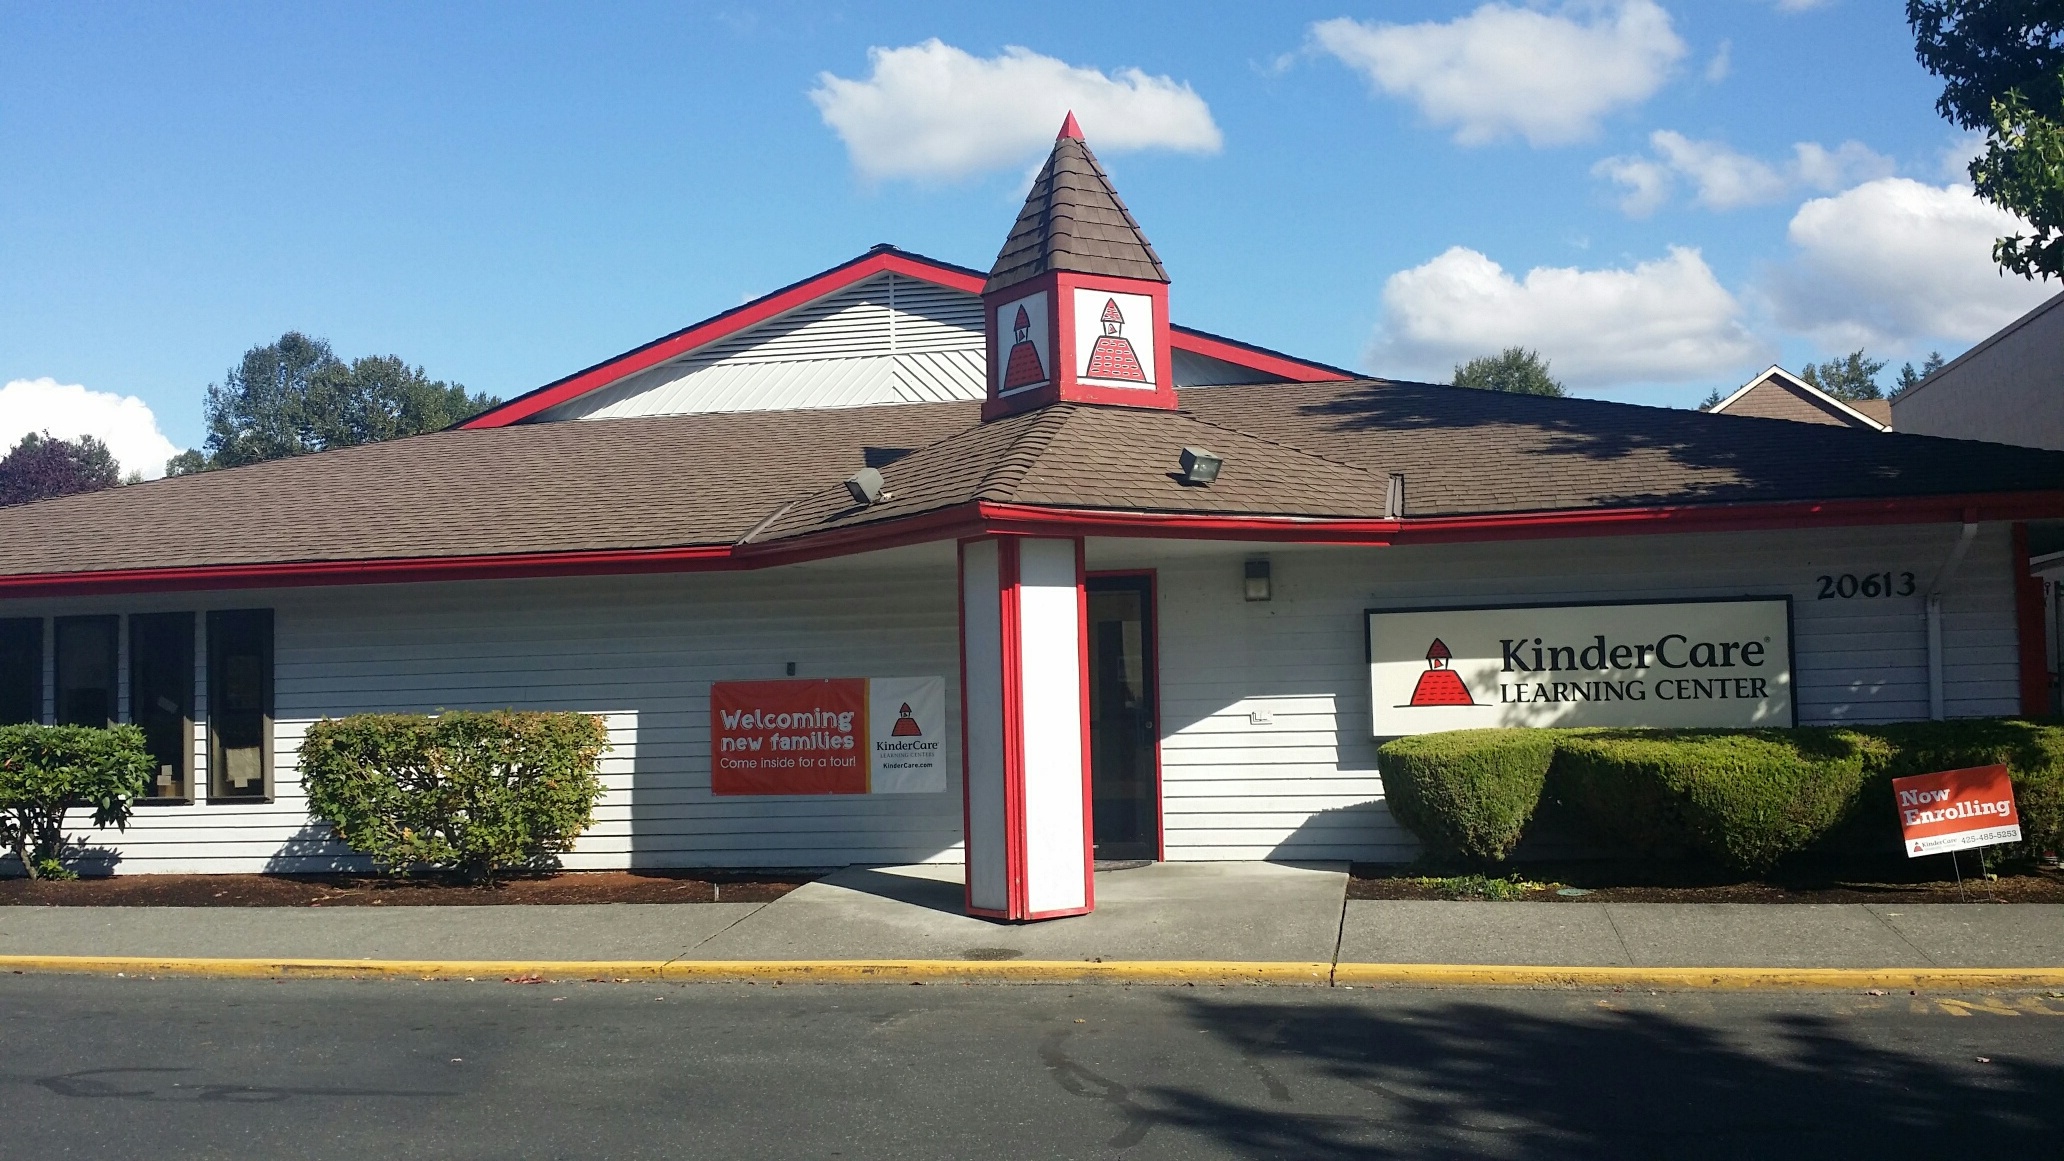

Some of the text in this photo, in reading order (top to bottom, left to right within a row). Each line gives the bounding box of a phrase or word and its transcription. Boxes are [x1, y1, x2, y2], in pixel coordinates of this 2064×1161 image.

[1817, 571, 1916, 600] 20613
[1499, 634, 1766, 672] KinderCare
[1500, 678, 1769, 703] LEARNING CENTER
[720, 708, 854, 731] Welcoming
[720, 732, 855, 752] new families
[876, 741, 938, 750] KinderCare
[720, 757, 857, 769] Come inside for a tour!
[1900, 789, 1950, 806] Now
[1904, 800, 2010, 825] Enrolling
[1922, 838, 1957, 847] KinderCare
